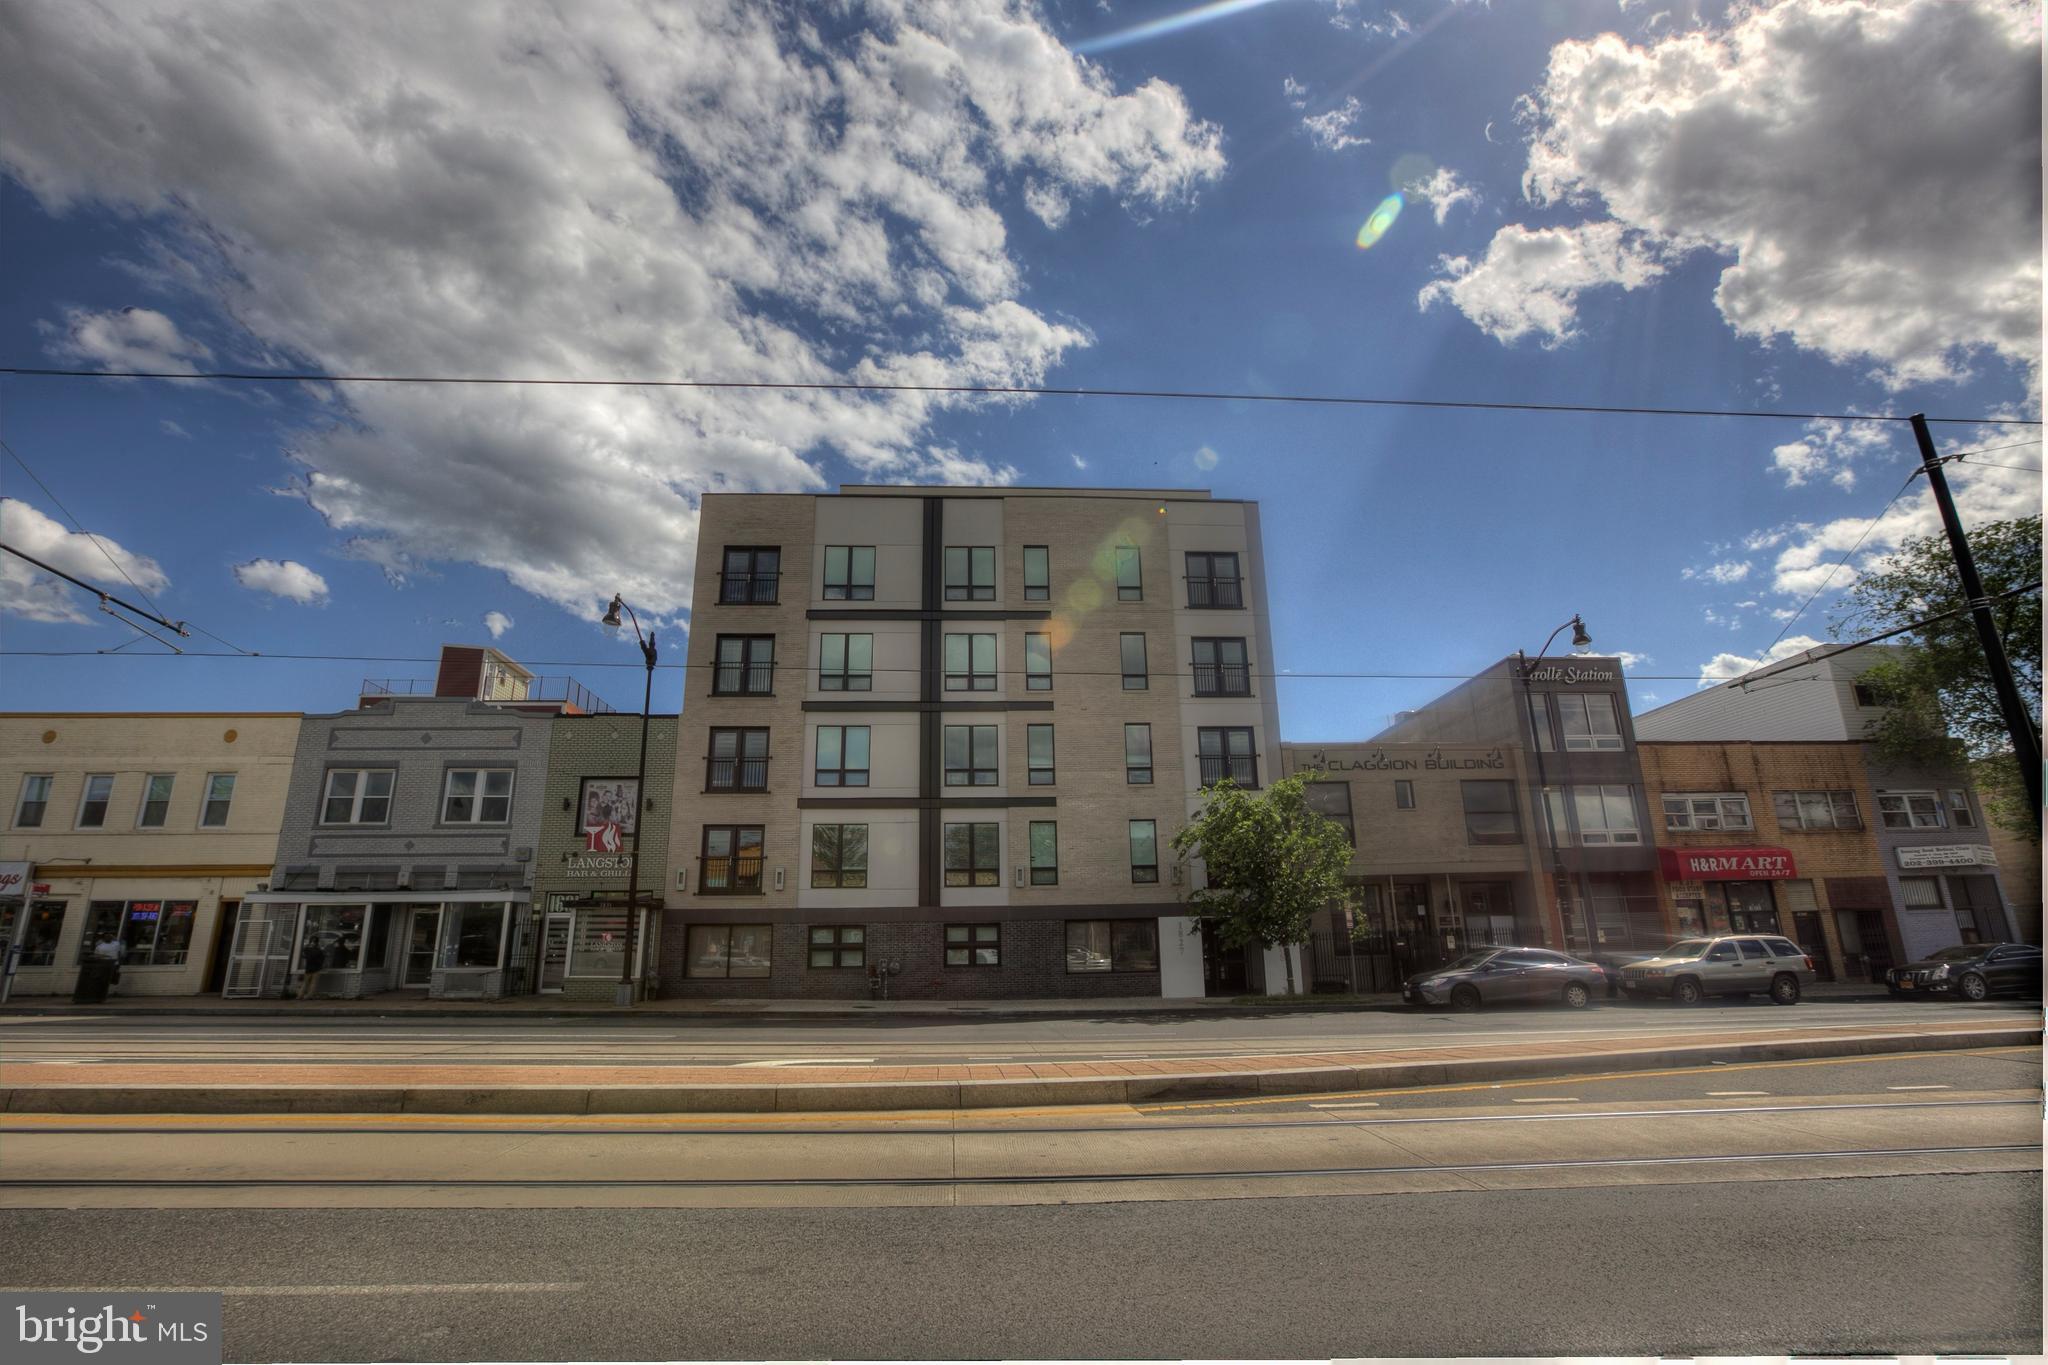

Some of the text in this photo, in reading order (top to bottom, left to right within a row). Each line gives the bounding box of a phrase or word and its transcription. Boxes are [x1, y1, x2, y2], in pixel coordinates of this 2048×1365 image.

[1564, 666, 1614, 684] Station
[1424, 759, 1505, 770] BUILDING
[1690, 856, 1787, 872] H&R MART
[1771, 869, 1791, 877] 24/7
